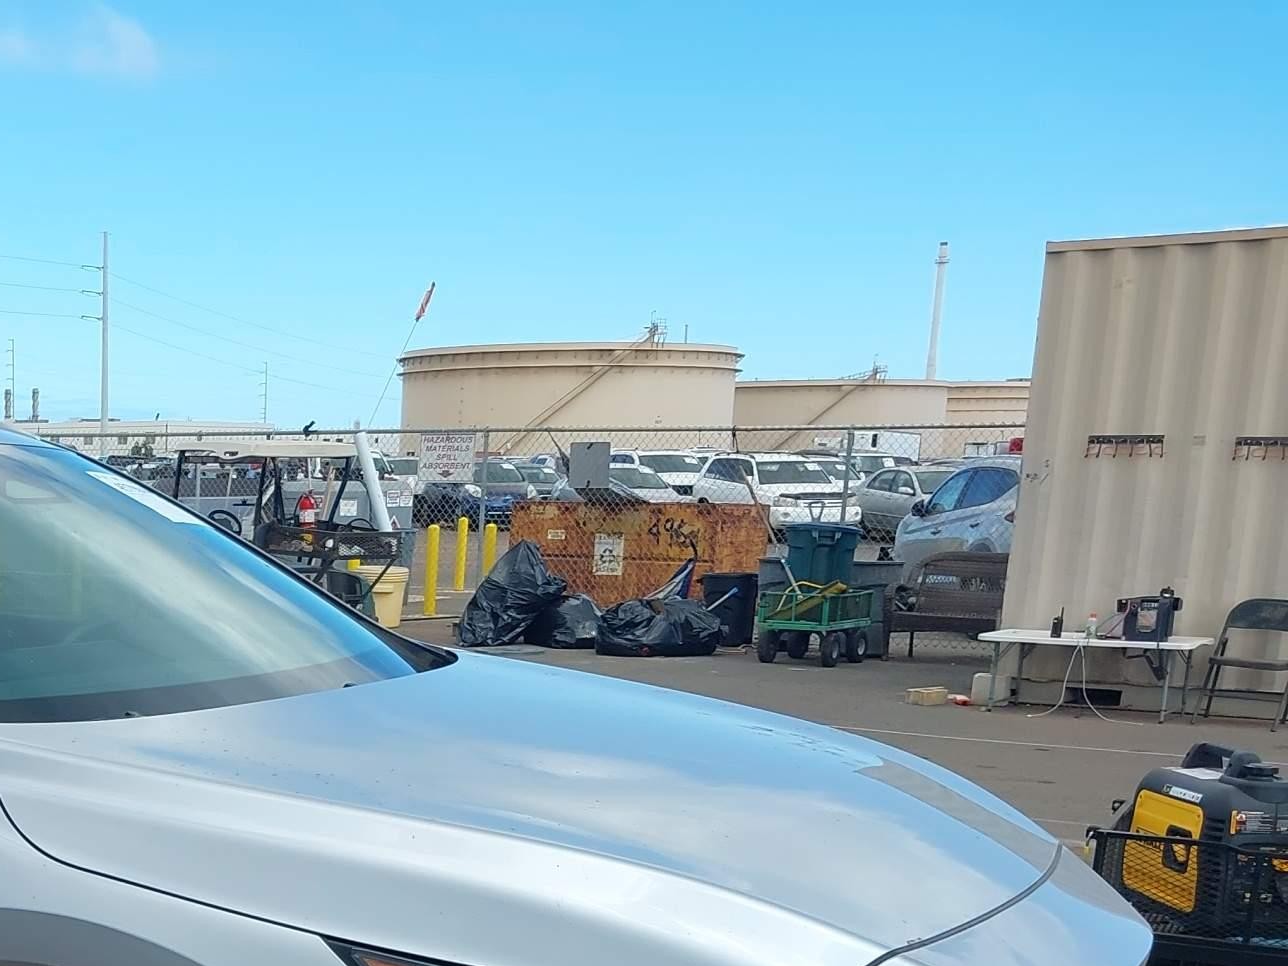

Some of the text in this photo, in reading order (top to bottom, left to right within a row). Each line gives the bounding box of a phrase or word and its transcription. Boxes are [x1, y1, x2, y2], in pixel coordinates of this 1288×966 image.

[423, 436, 474, 444] HAZARDOUS
[436, 453, 458, 461] SPILL
[421, 462, 472, 470] ABSORBENT
